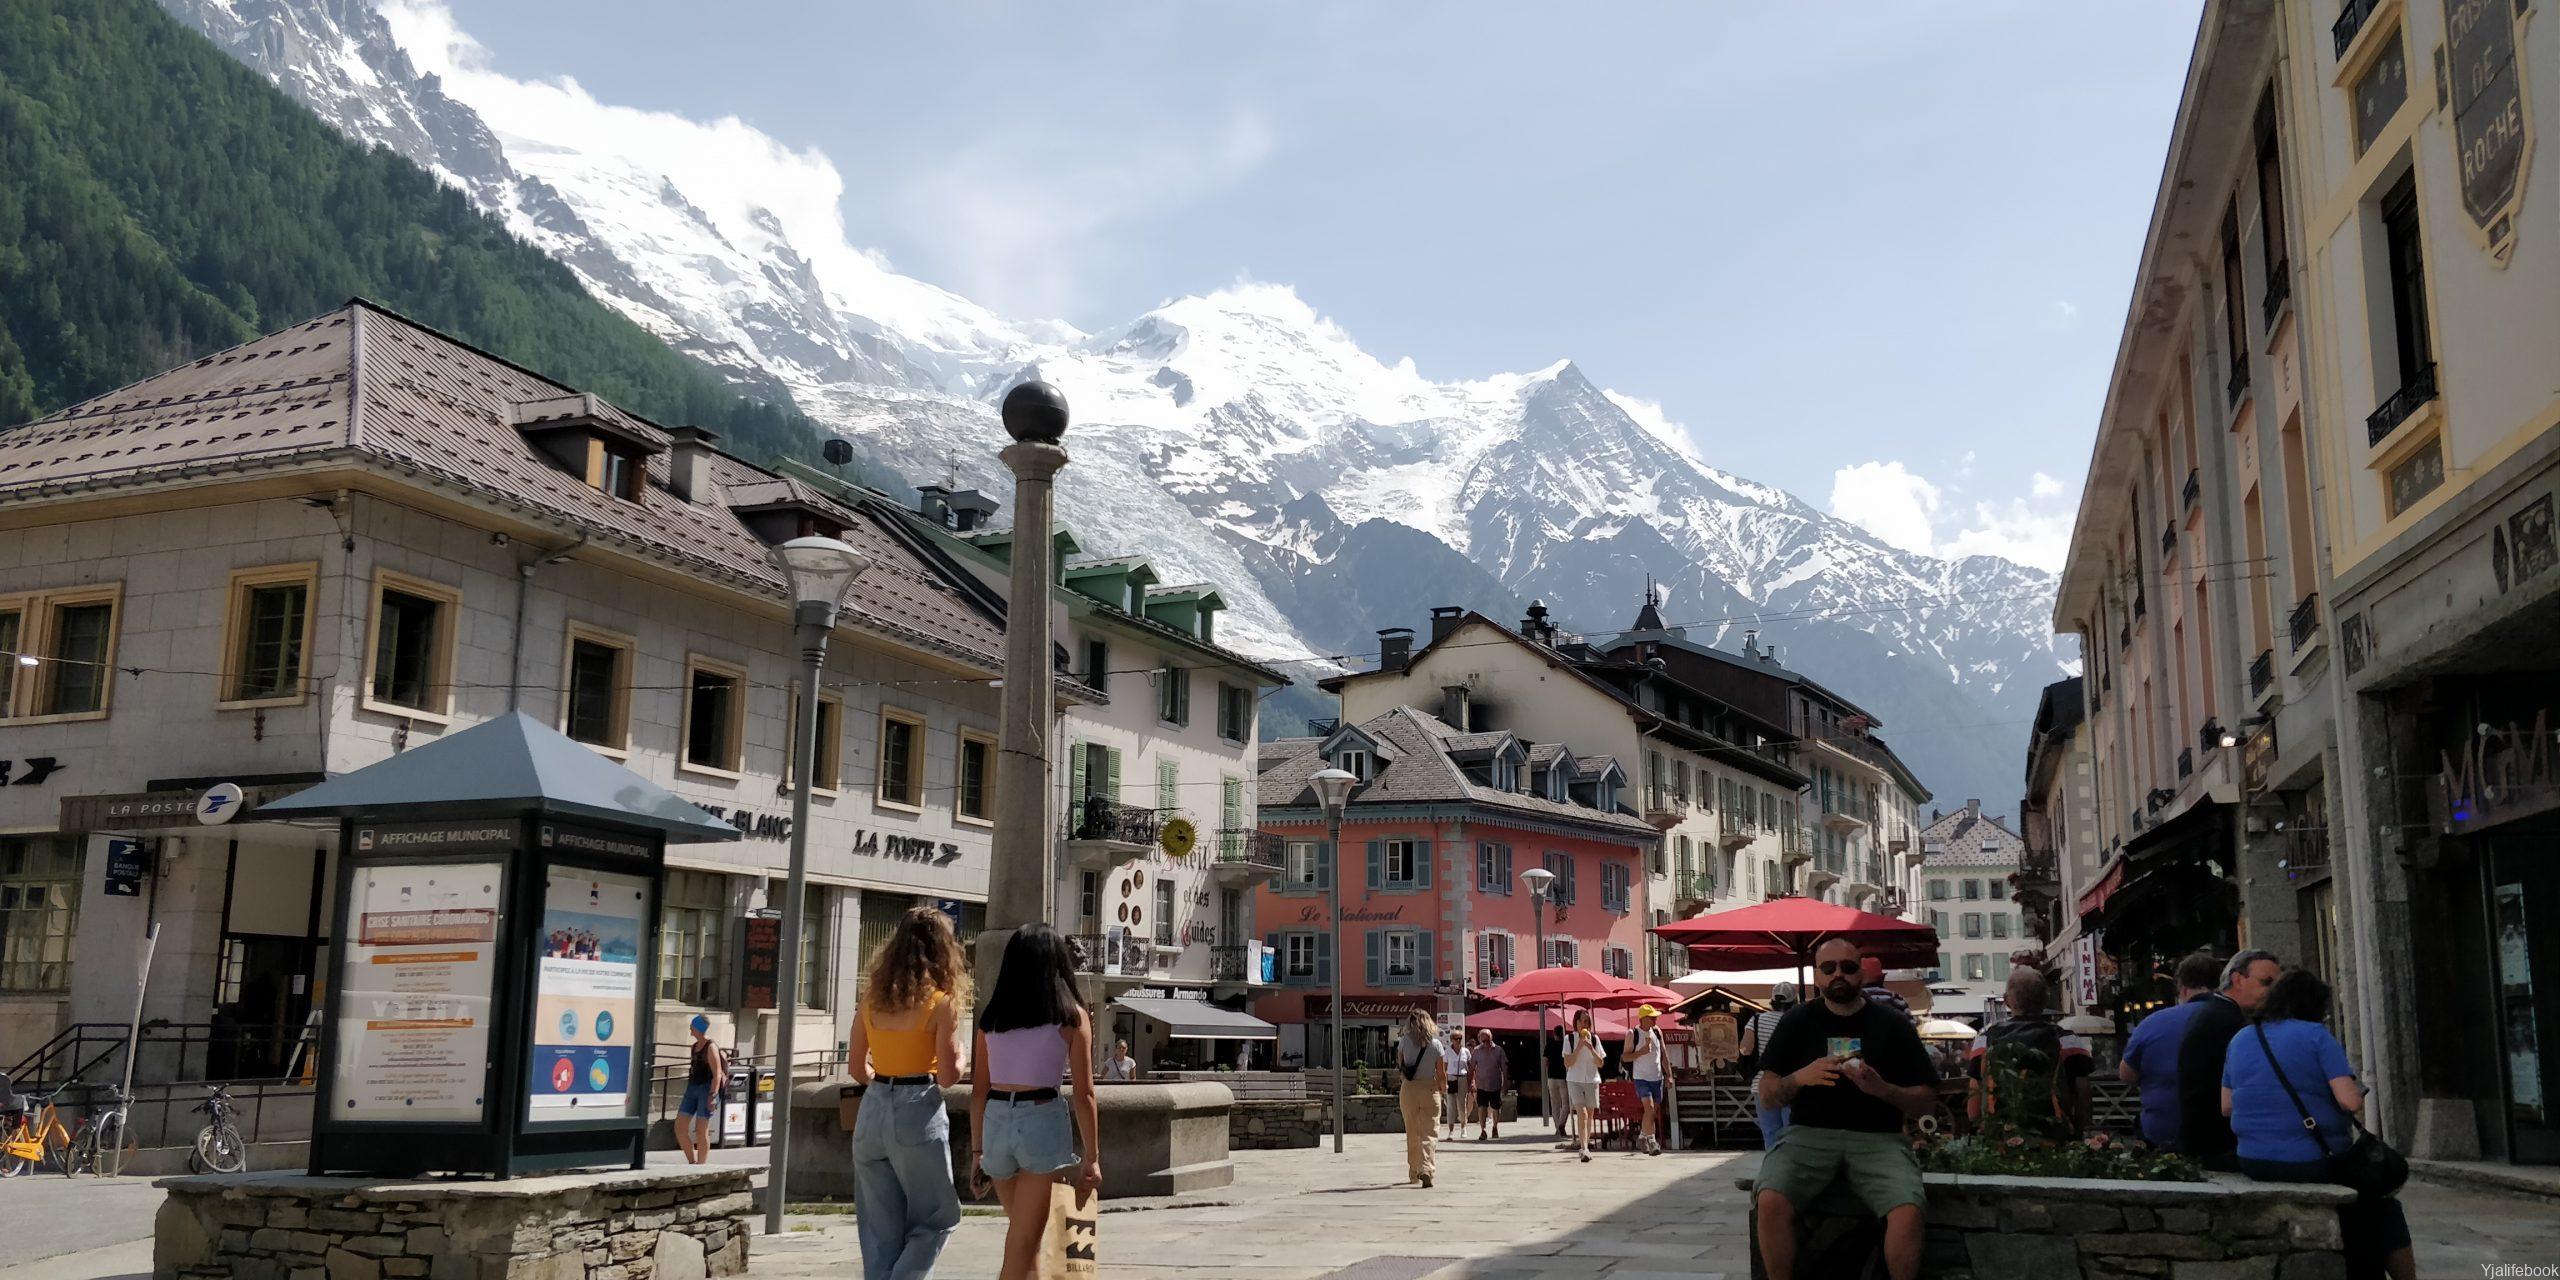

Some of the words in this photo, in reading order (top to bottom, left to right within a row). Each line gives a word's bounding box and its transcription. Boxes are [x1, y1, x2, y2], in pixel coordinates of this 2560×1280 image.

[2473, 45, 2495, 98] DE
[2464, 97, 2519, 186] ROCHE
[111, 805, 130, 815] LA
[140, 802, 196, 814] POSTE
[381, 831, 444, 845] AFFICHAGE
[446, 829, 511, 842] MUNICIPAL
[559, 834, 607, 851] AFFICHAGE
[607, 840, 650, 858] MUNICIPAL
[853, 829, 878, 855] LA
[885, 834, 935, 862] POSTE
[1183, 886, 1192, 904] et
[1194, 886, 1210, 908] des
[366, 916, 390, 929] CRISE
[390, 914, 432, 928] SANITAIRE
[432, 911, 490, 926] CORONAVIRUS
[1299, 905, 1320, 922] Le
[1181, 919, 1216, 947] Guides
[2082, 941, 2094, 1001] INEMA
[1123, 988, 1165, 999] haussures
[1172, 987, 1207, 1000] Armando
[1344, 1001, 1417, 1016] National
